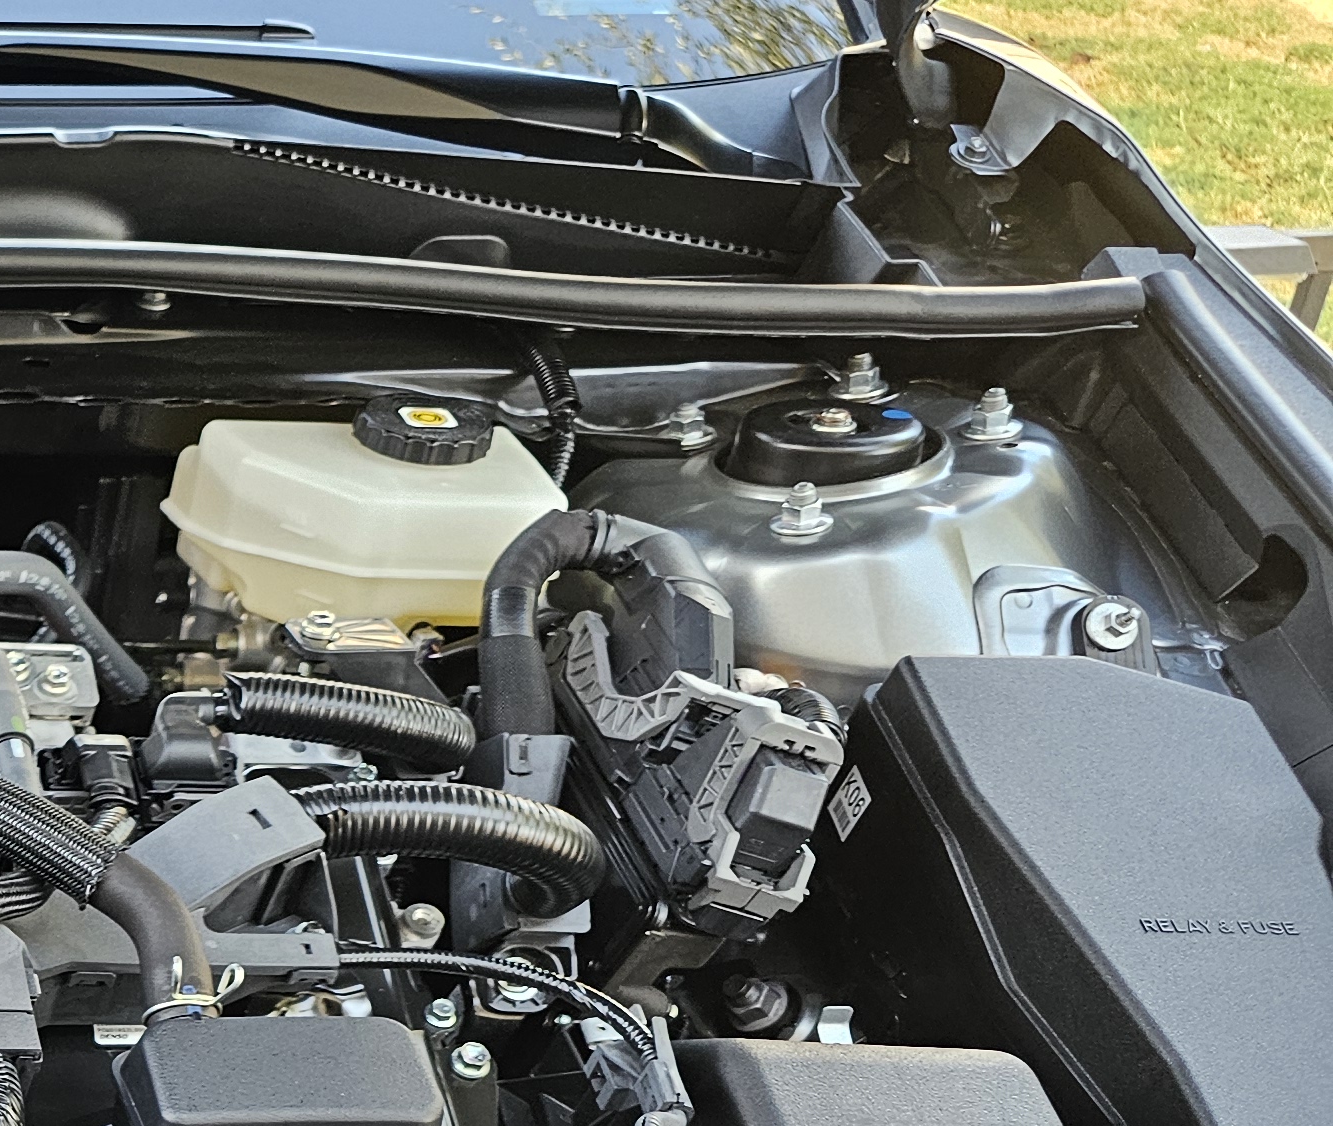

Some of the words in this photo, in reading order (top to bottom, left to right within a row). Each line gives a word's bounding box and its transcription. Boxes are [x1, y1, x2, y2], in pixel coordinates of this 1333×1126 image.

[1139, 918, 1211, 934] RELAY
[1218, 919, 1235, 934] &
[1237, 920, 1301, 936] FUSE
